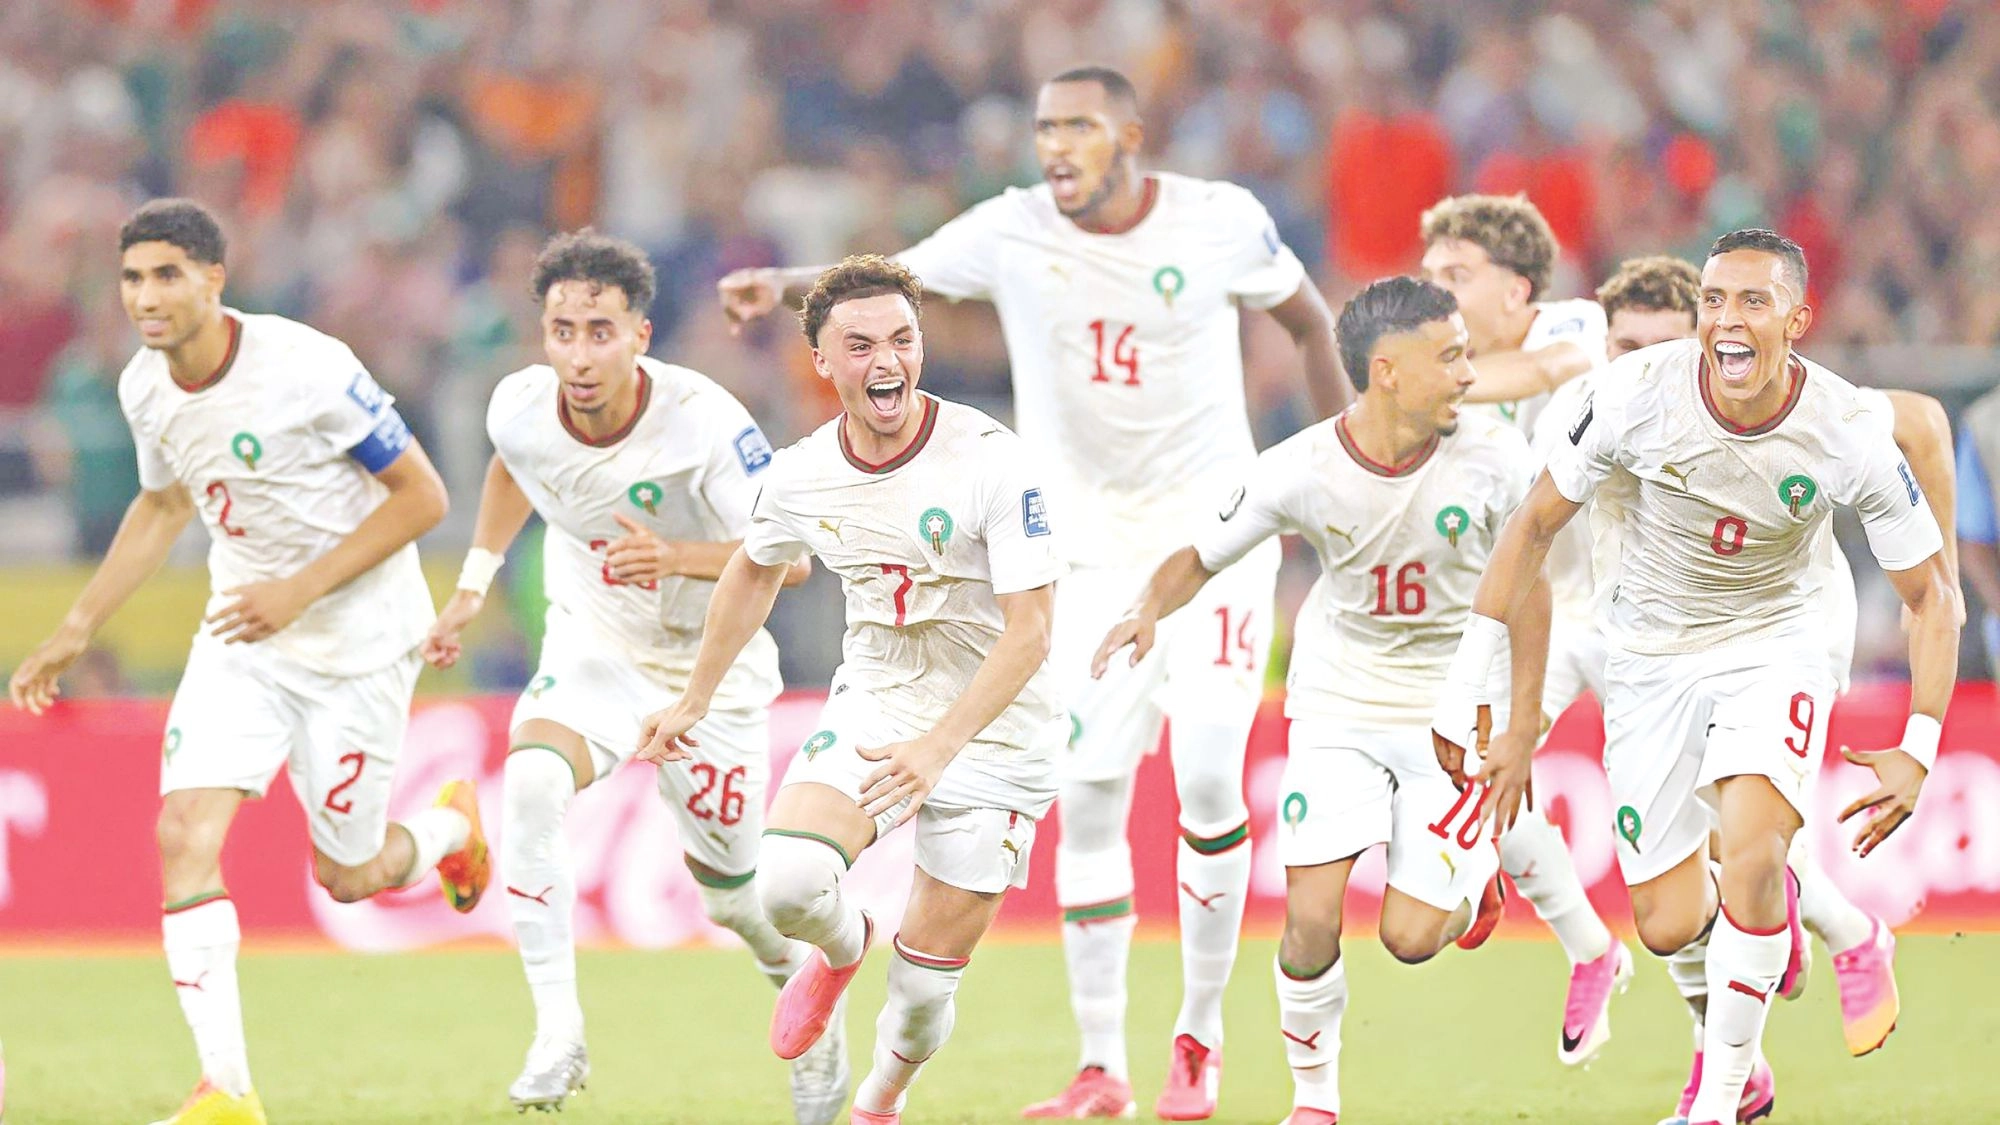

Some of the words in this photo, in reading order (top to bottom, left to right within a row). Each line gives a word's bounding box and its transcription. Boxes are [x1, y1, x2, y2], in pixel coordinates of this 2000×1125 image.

[1088, 318, 1141, 388] 14
[206, 480, 246, 537] 2
[880, 562, 913, 628] 7
[1369, 560, 1428, 617] 16
[1213, 606, 1254, 671] 14
[1784, 691, 1815, 759] 9
[324, 752, 366, 815] 2
[686, 761, 747, 828] 26
